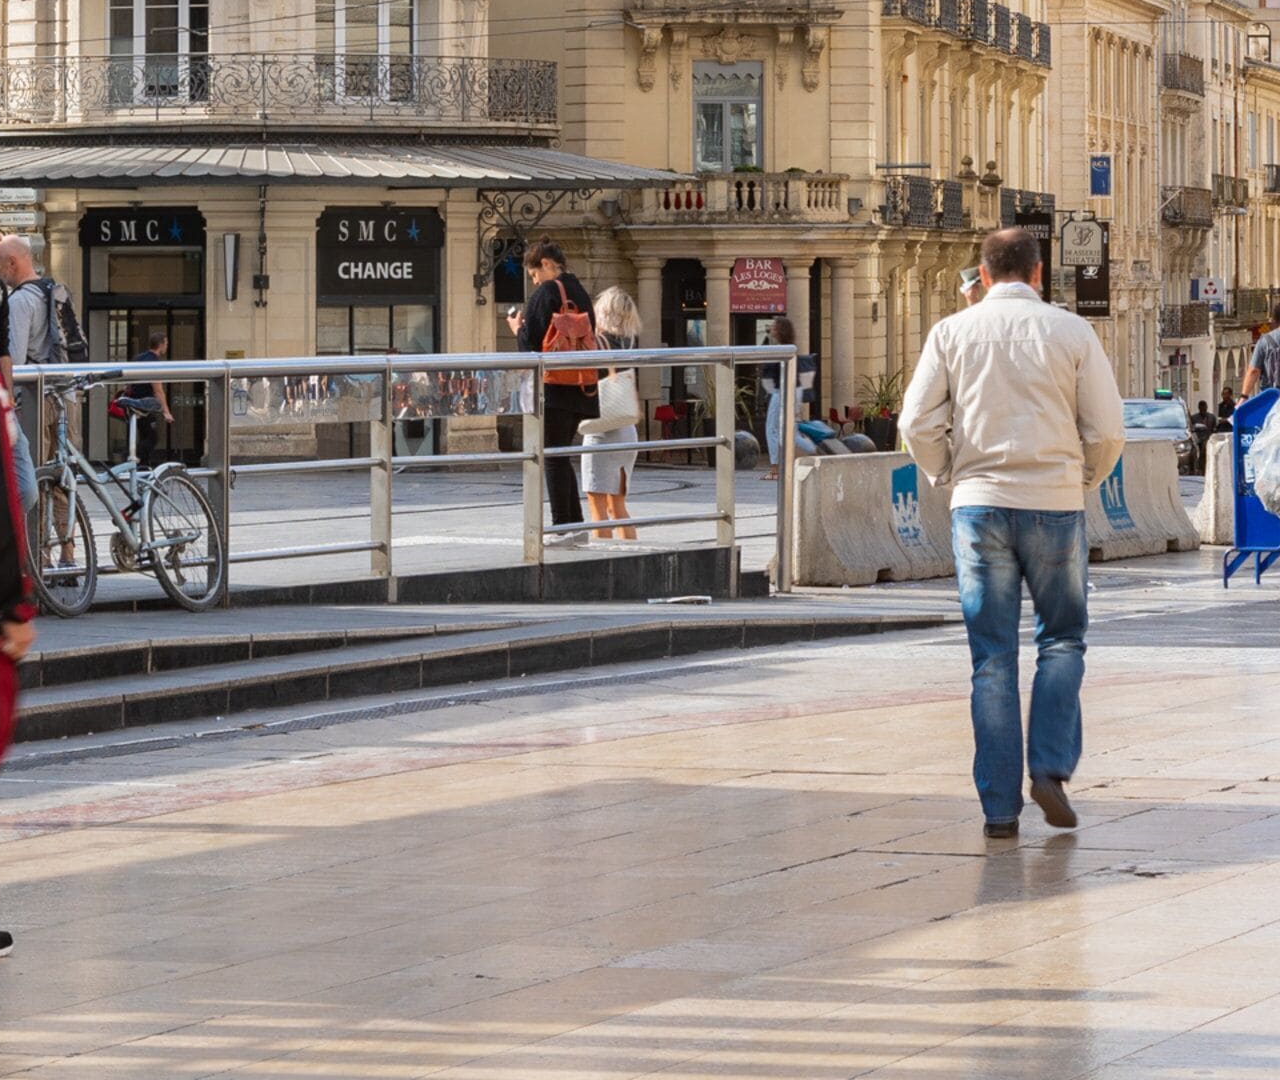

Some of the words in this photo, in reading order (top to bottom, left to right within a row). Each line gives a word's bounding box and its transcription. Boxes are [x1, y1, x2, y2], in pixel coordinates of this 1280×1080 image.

[101, 219, 159, 242] SMC
[338, 219, 397, 242] SMC
[338, 261, 413, 279] CHANGE
[746, 258, 772, 270] BAR
[734, 271, 752, 283] LES
[753, 270, 783, 283] LOGES
